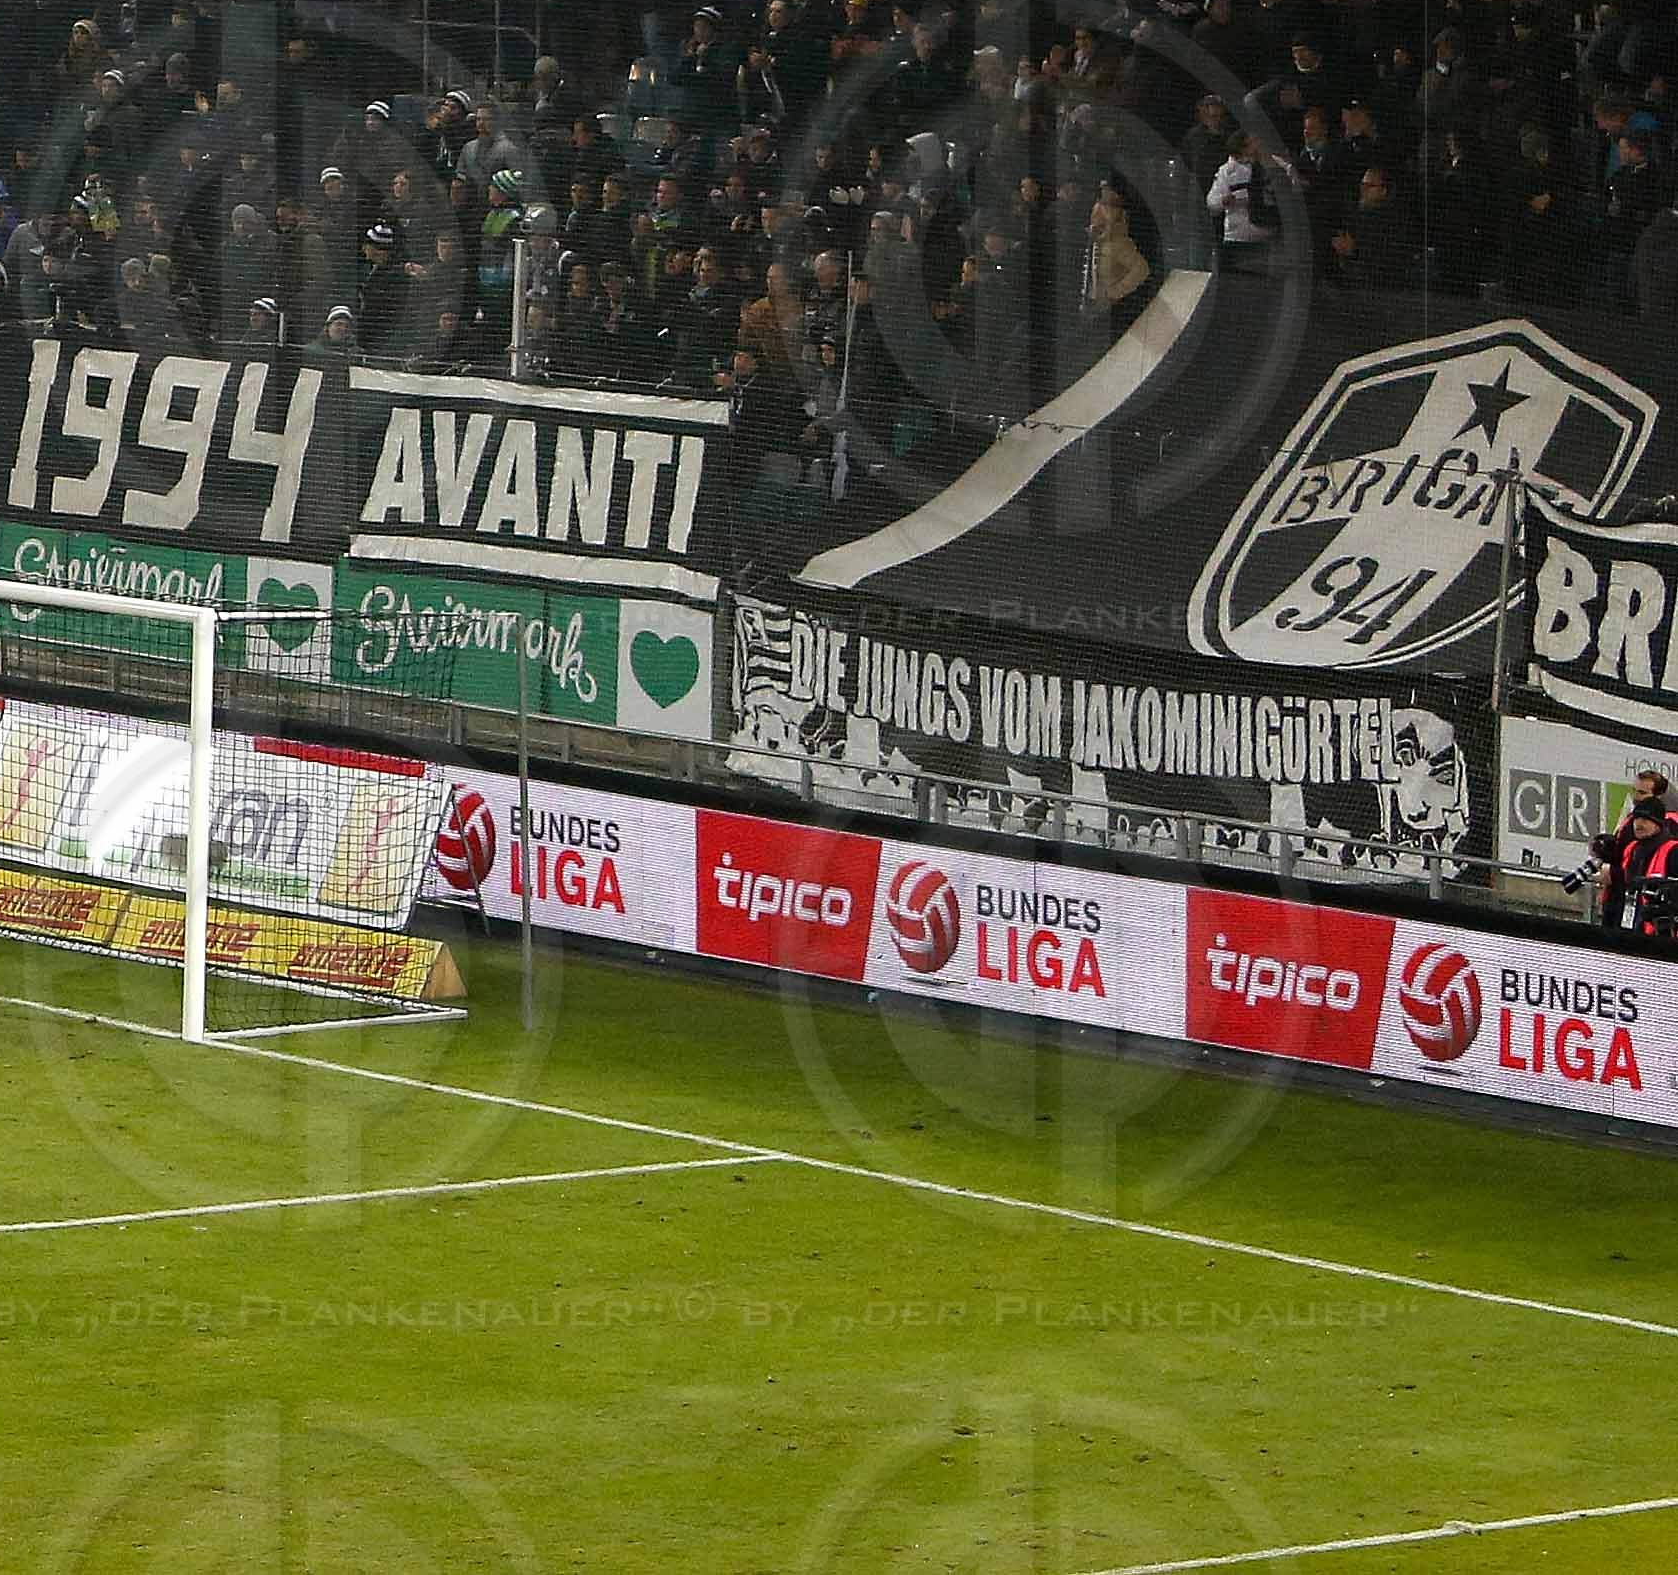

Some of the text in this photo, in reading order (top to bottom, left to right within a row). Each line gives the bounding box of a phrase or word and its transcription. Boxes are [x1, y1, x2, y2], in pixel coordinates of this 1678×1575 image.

[6, 338, 324, 544] 1994
[360, 407, 707, 555] AVANTI
[1275, 556, 1438, 645] 94
[357, 585, 598, 703] Steiermark
[789, 613, 847, 715] DIE
[854, 635, 971, 744] JUNGS
[979, 664, 1062, 759] VOM
[1071, 680, 1403, 785] JAKOMINIGÜRTEL
[510, 805, 621, 853] BUNDES
[510, 841, 626, 915] LIGA
[713, 851, 852, 926] tipico
[976, 885, 1102, 931] BUNDES
[143, 917, 260, 953] antnne
[976, 921, 1107, 999] LIGA
[1205, 933, 1361, 1010] tipico
[1500, 970, 1639, 1023] BUNDES
[1499, 1008, 1643, 1092] LIGA
